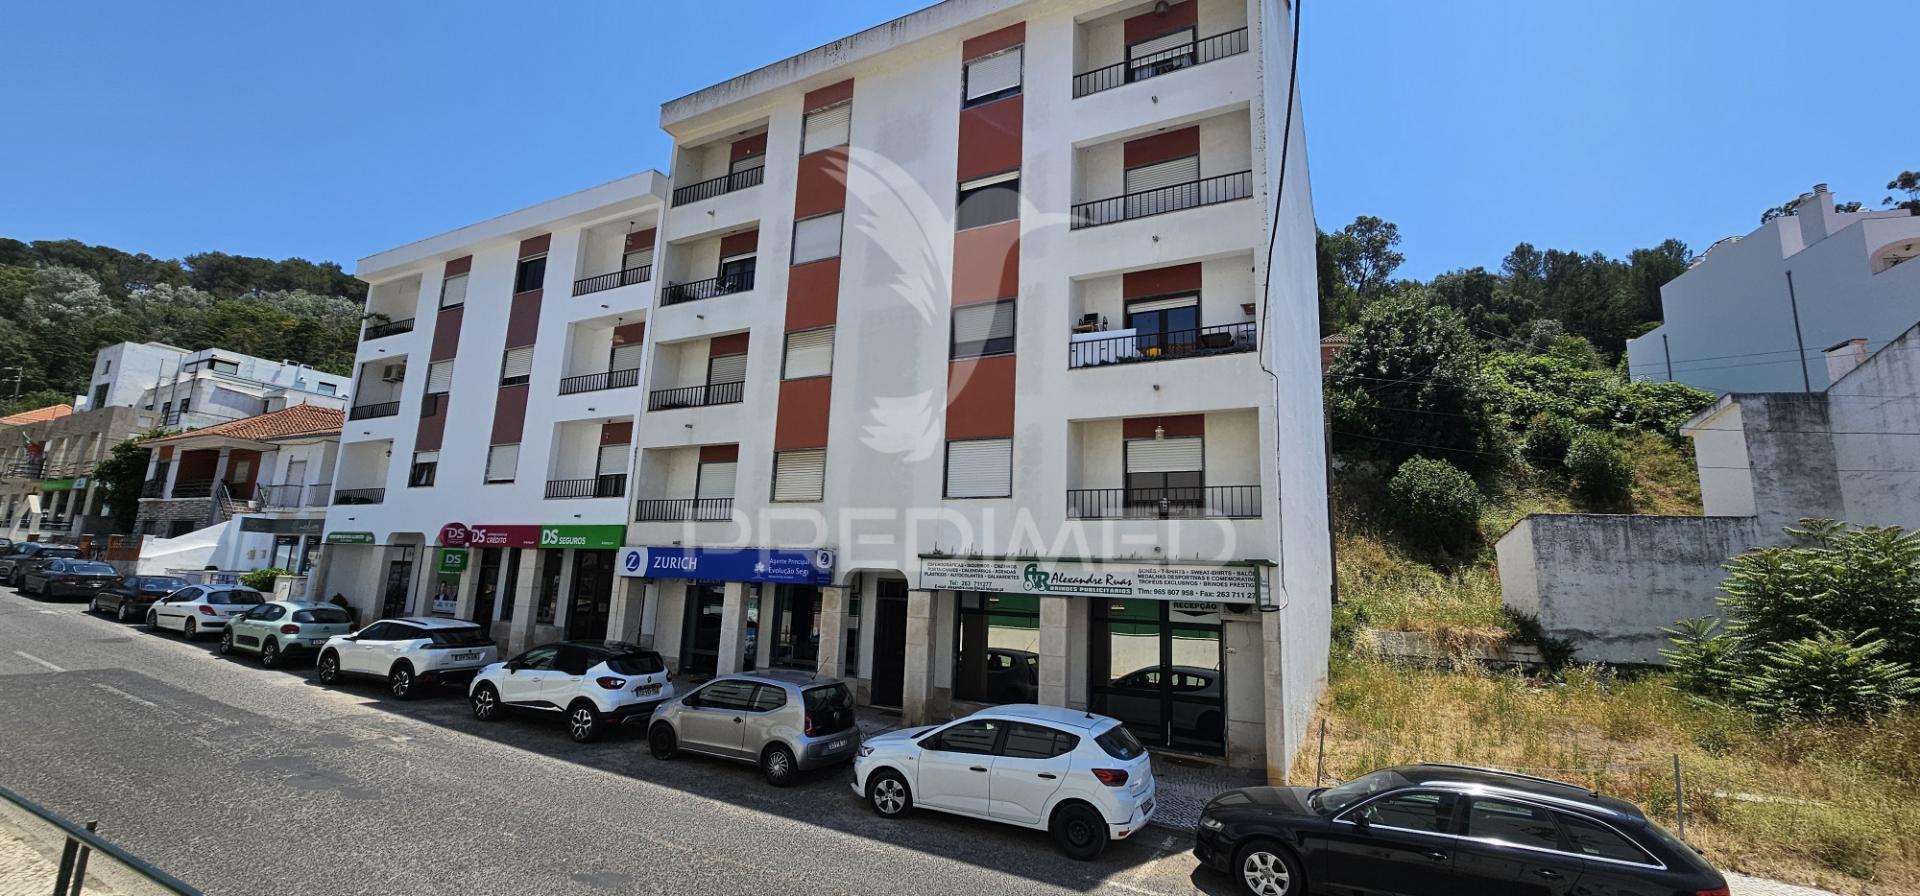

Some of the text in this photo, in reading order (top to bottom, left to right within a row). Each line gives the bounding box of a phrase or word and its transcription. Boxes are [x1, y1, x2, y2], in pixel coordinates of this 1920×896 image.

[446, 528, 465, 539] DS
[472, 529, 486, 544] DS
[541, 529, 559, 545] DS
[558, 537, 586, 545] SEGUROS
[446, 554, 461, 564] DS
[653, 556, 697, 570] ZURICH
[769, 558, 810, 566] Agente Principal
[768, 567, 795, 575] Evolução
[1051, 572, 1133, 586] Alexandre Ruas
[1173, 601, 1217, 610] RECEPÇÃO
